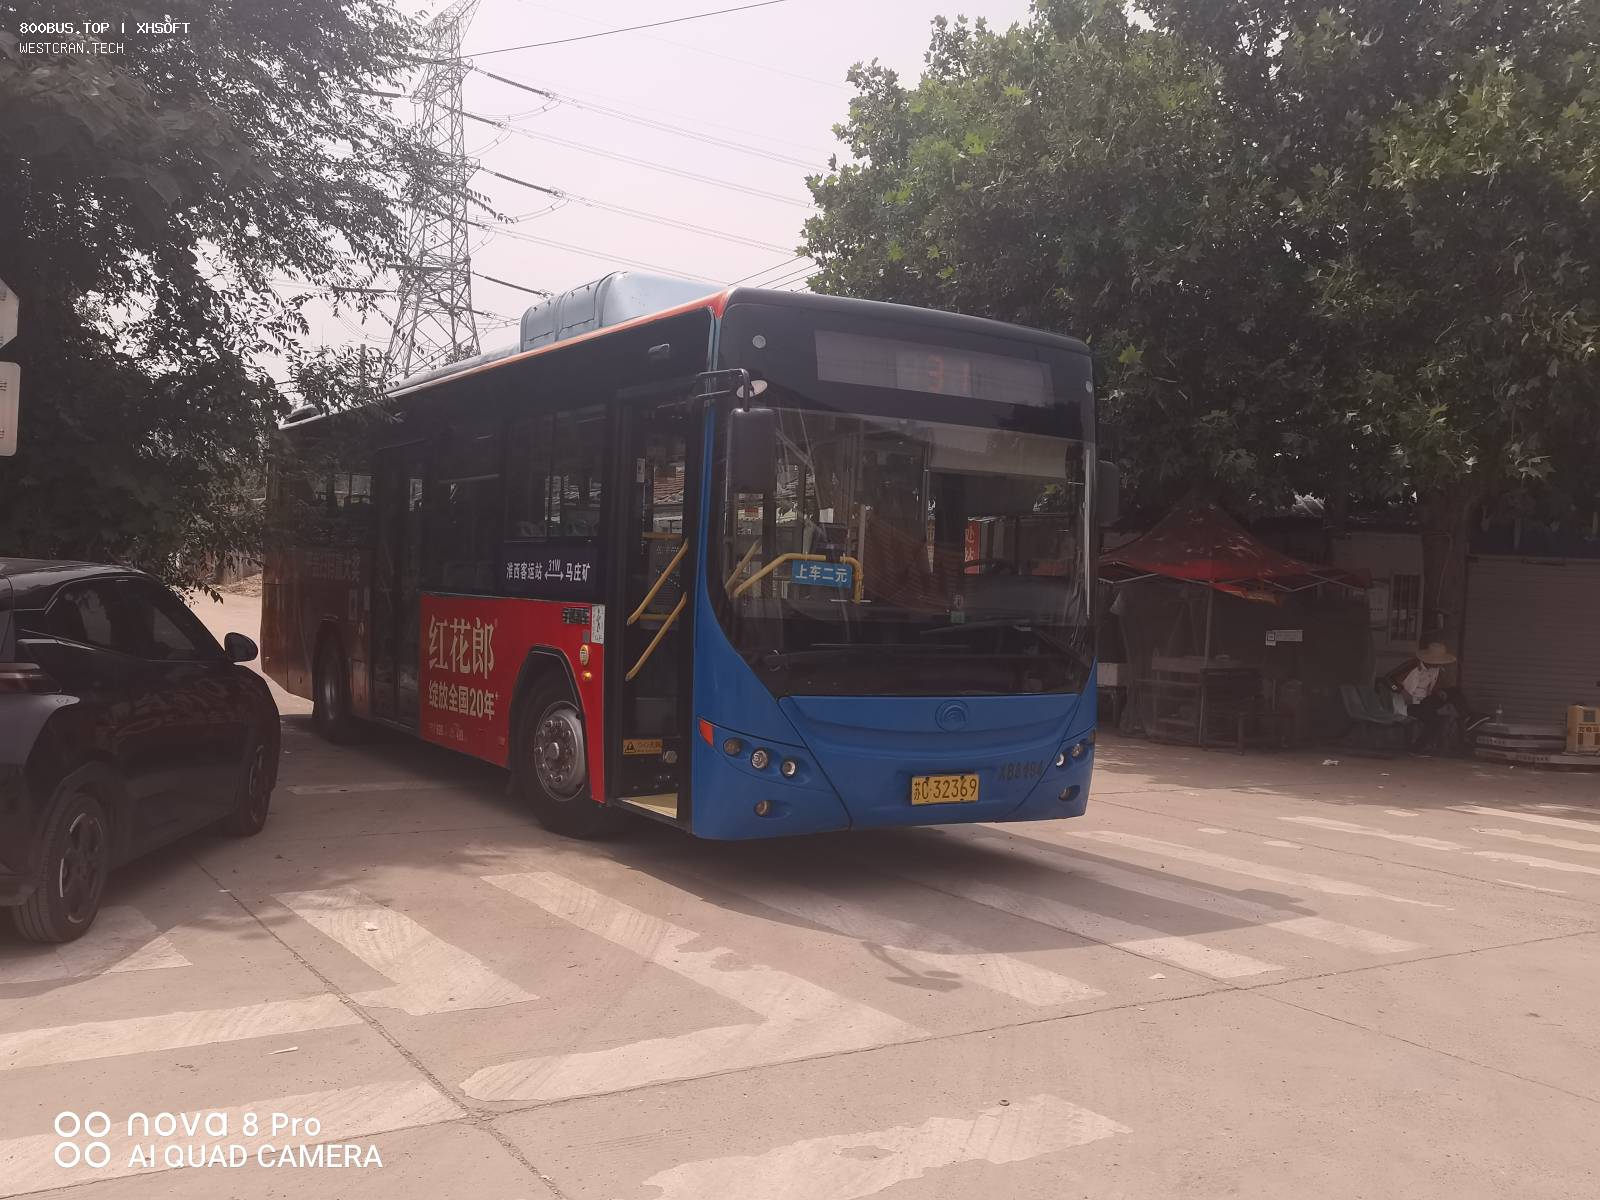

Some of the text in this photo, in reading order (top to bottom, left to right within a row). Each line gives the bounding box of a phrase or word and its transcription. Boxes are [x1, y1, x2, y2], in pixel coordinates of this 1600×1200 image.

[506, 562, 543, 580] 淮西客运站
[565, 562, 591, 583] 马庄矿
[795, 563, 848, 583] 上车二元
[428, 614, 495, 679] 红花郎
